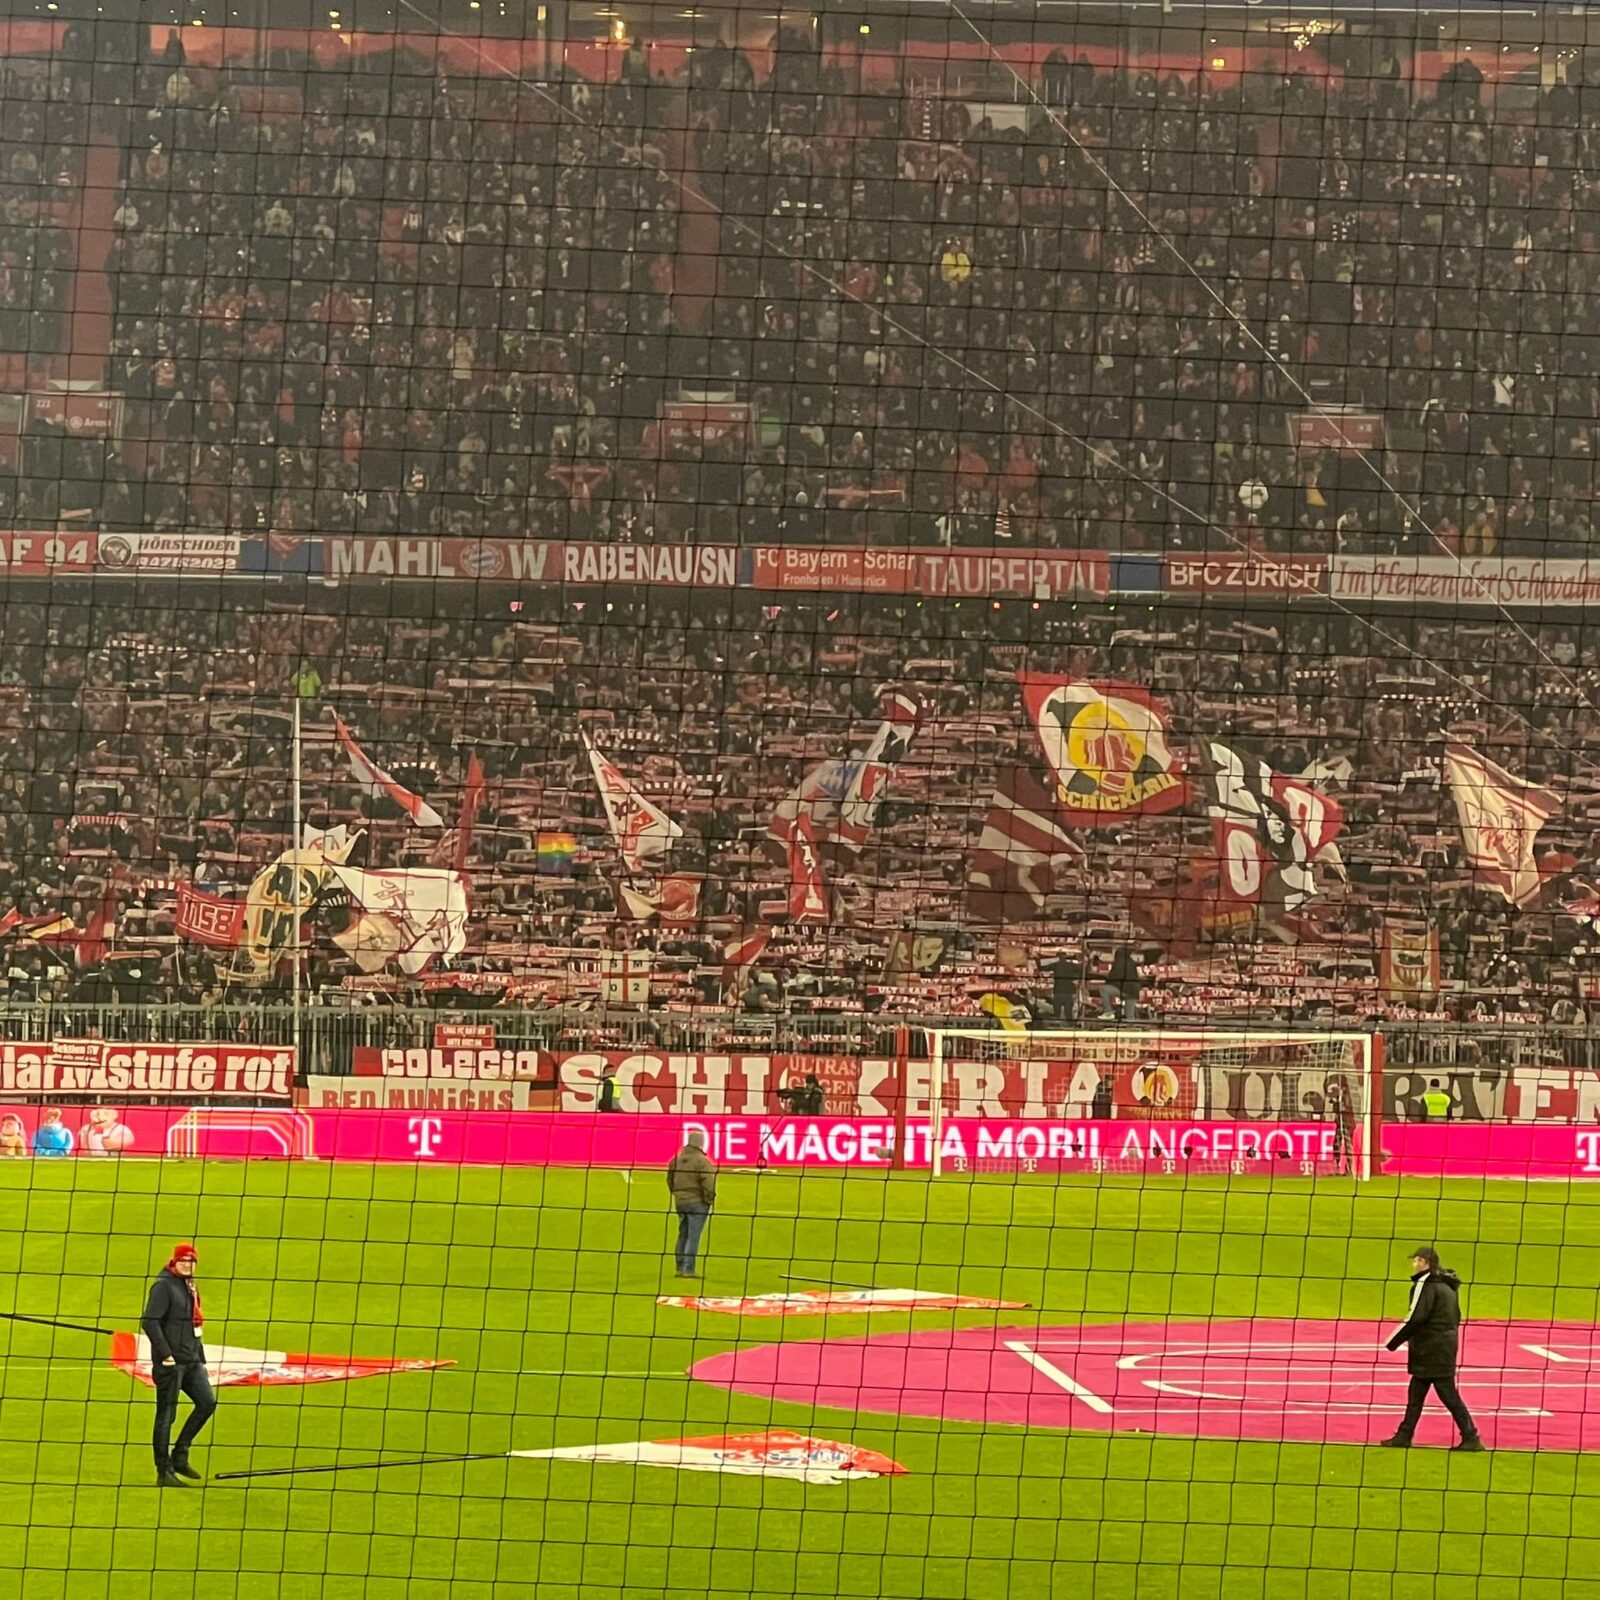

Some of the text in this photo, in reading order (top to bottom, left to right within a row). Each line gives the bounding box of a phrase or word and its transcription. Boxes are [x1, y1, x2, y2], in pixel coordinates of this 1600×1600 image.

[44, 539, 88, 568] 94
[139, 537, 235, 551] HÖRSCHDER
[331, 540, 455, 578] MAHL
[565, 547, 736, 585] RABENAU/SN
[756, 549, 778, 567] FC
[786, 550, 848, 572] Bayern
[1169, 559, 1321, 588] BFC ZÜRICH
[784, 574, 833, 586] Fronhoen
[925, 556, 1107, 593] TAUBERTAL
[1335, 561, 1367, 594] Im
[1372, 562, 1455, 595] Herzen
[1457, 561, 1496, 595] der
[633, 982, 641, 992] 2
[224, 1052, 291, 1094] rot
[789, 1056, 859, 1076] ULTRAS
[323, 1090, 377, 1109] RED
[560, 1054, 1117, 1119] SCHIKERIA
[788, 1076, 857, 1095] GGEN
[682, 1122, 747, 1160] DIE
[977, 1126, 1099, 1159] MOBIL
